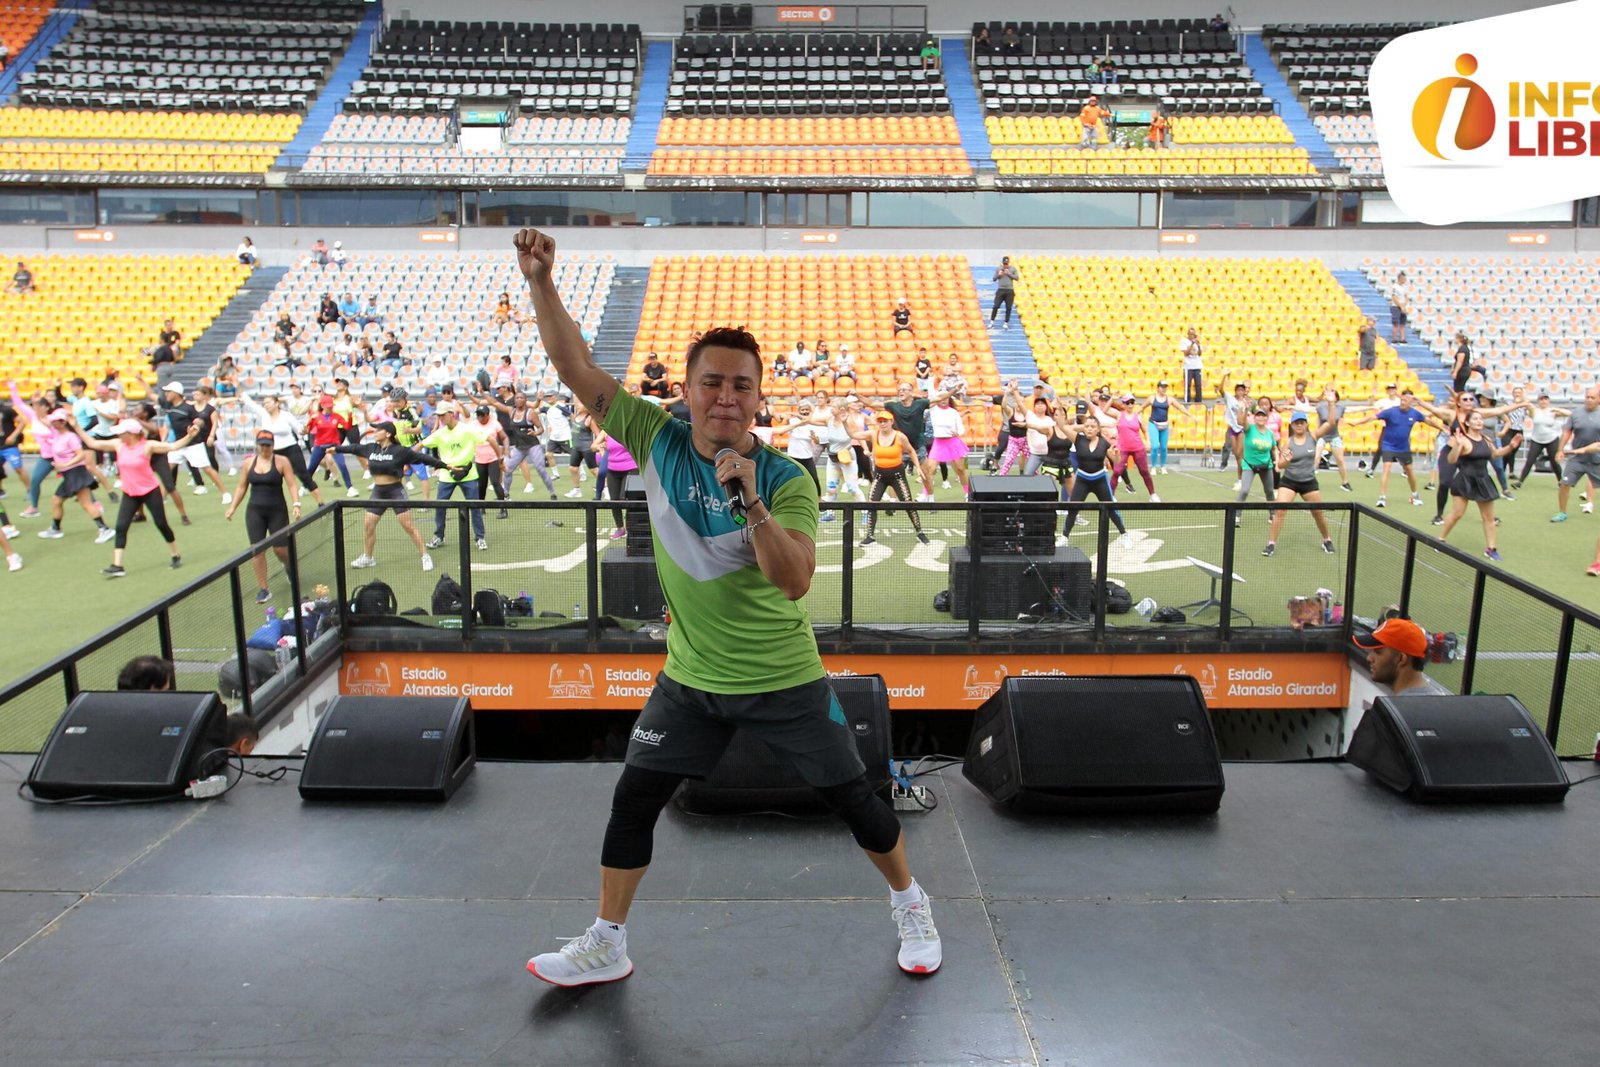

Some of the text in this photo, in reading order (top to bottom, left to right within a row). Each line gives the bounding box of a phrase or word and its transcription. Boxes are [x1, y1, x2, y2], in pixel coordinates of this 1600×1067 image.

[781, 10, 814, 18] SECTOR
[401, 667, 447, 680] Estadio
[605, 668, 651, 681] Estadio
[1227, 668, 1273, 681] Estadio
[402, 683, 513, 696] Atanasio Girardot
[606, 684, 655, 697] Atanasi
[886, 684, 925, 697] rardot
[1227, 682, 1338, 696] Atanasio Girardot
